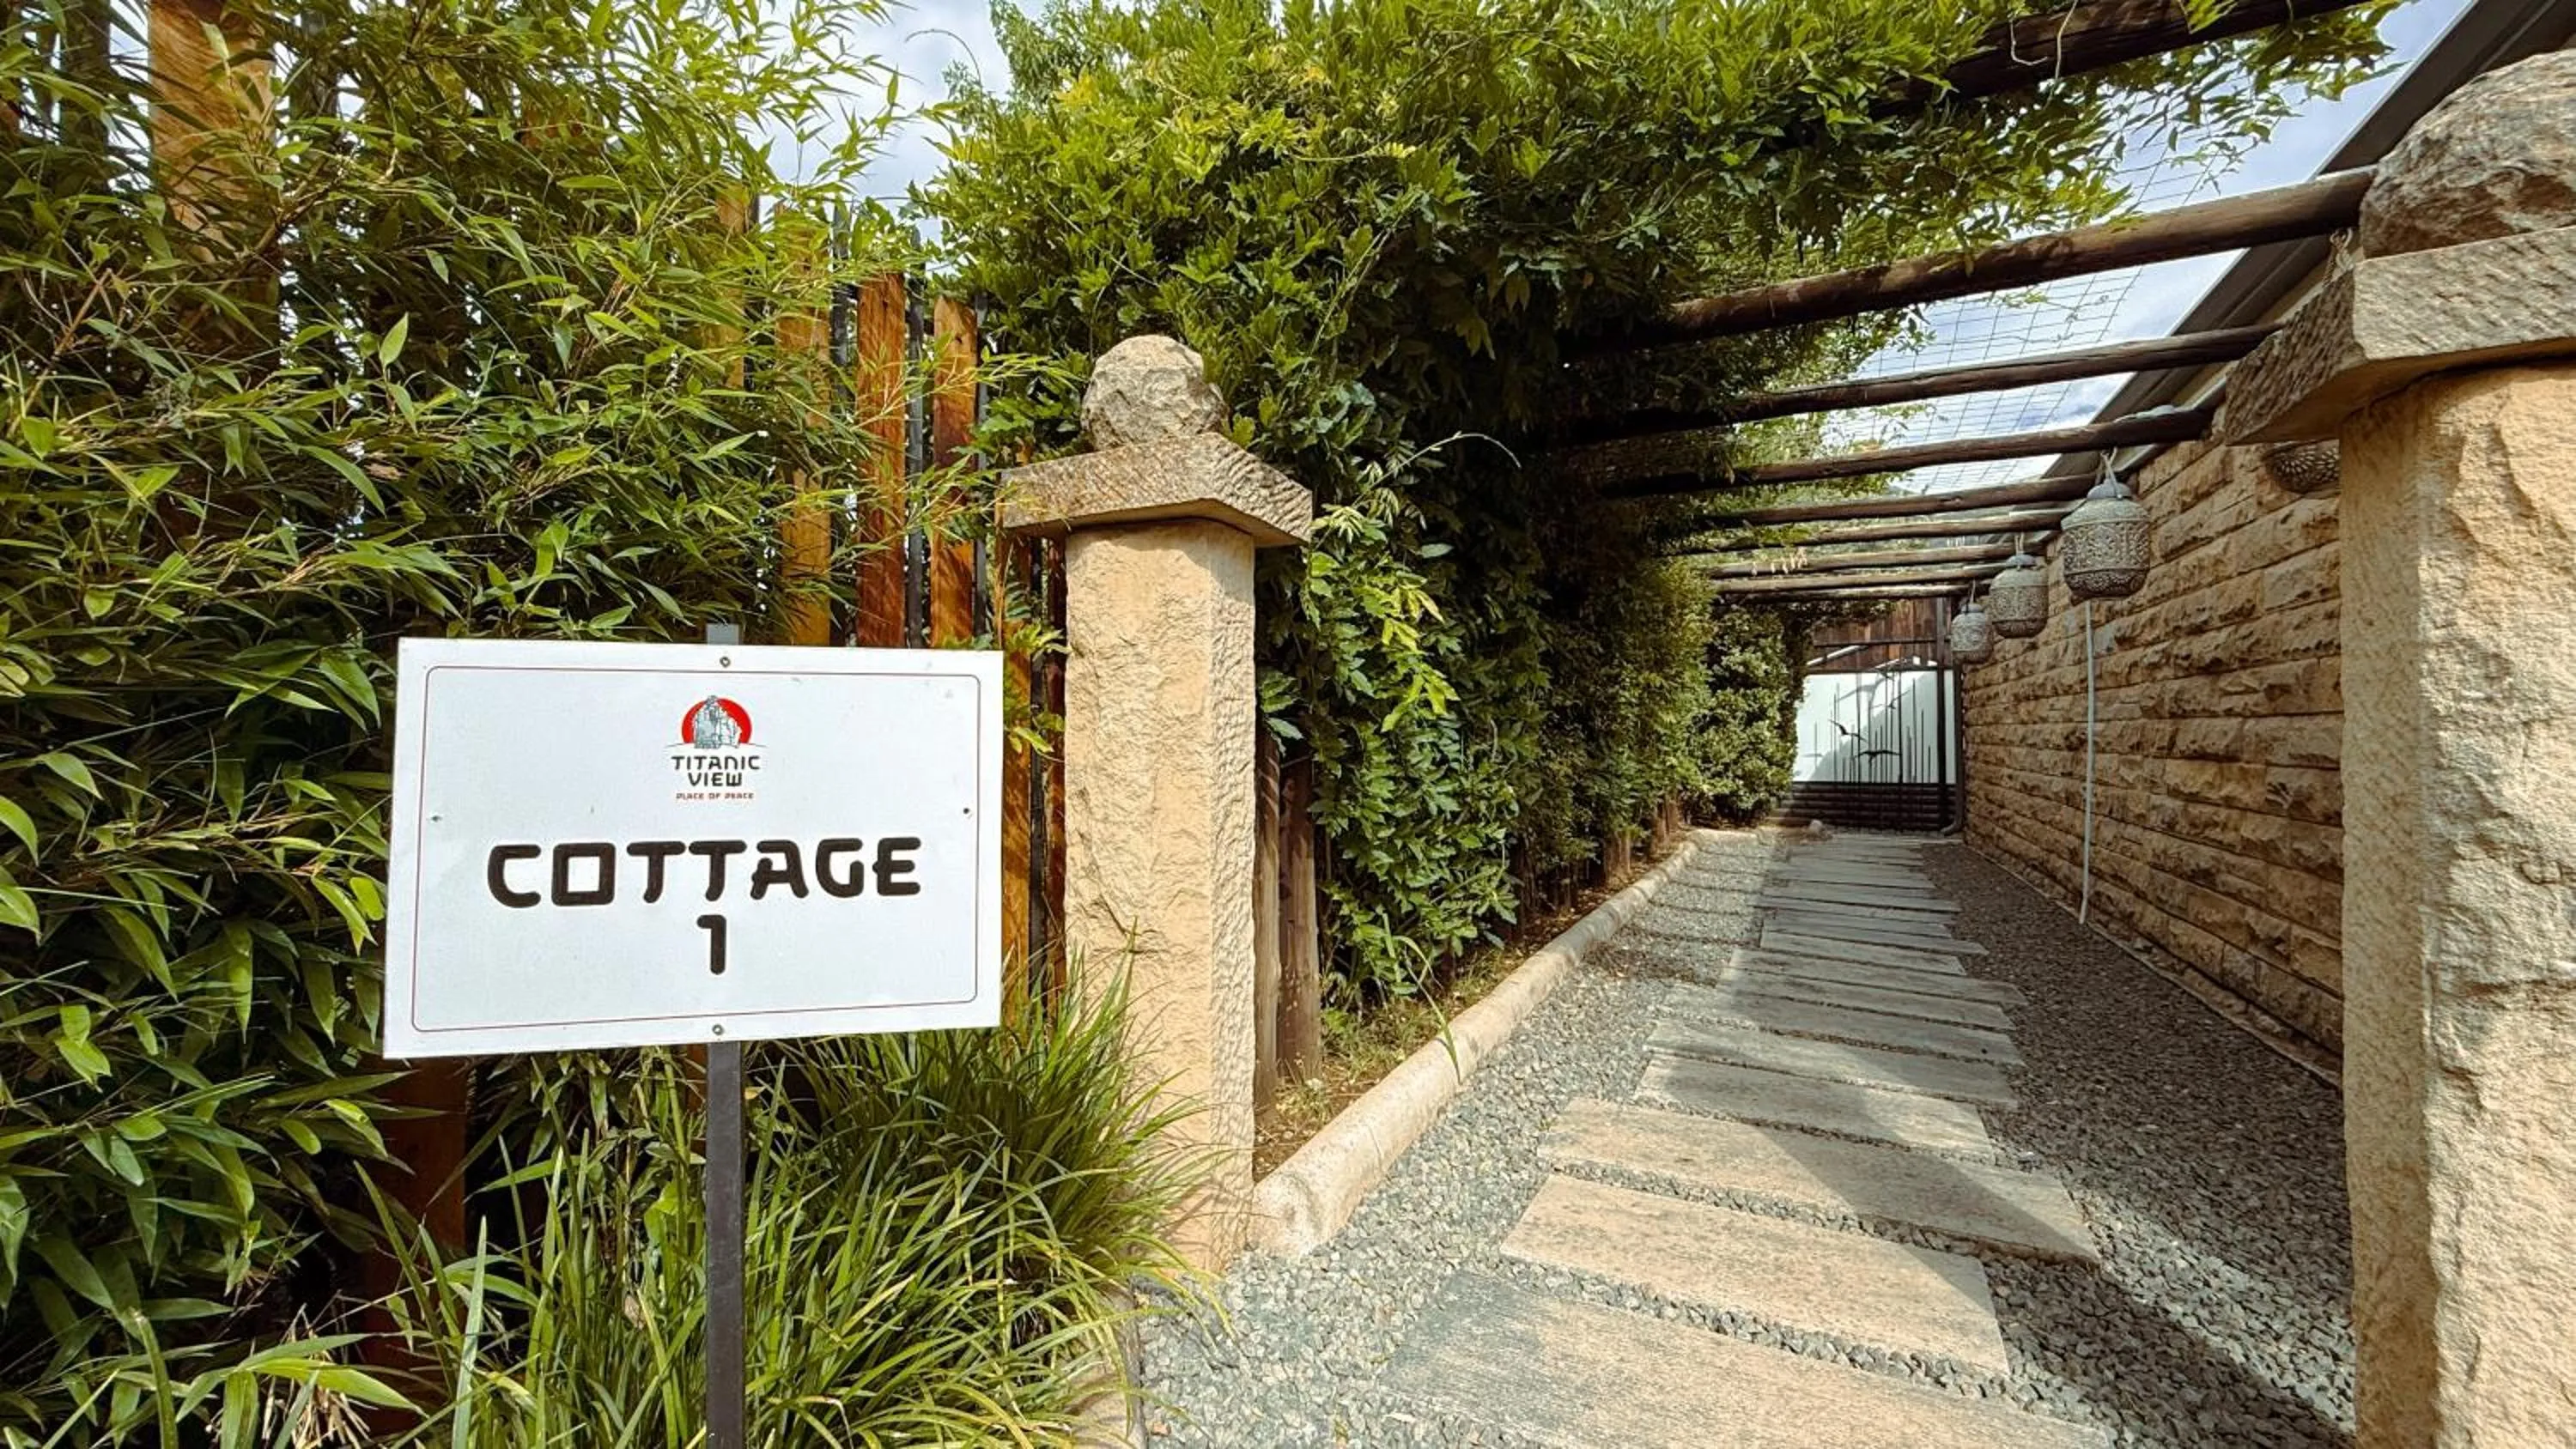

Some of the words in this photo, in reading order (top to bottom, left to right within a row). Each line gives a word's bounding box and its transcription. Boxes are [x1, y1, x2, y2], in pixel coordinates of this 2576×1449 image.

[671, 755, 761, 770] TITANIC
[688, 772, 743, 787] VIEW
[487, 837, 921, 908] COTTAGE
[696, 914, 726, 975] 1
